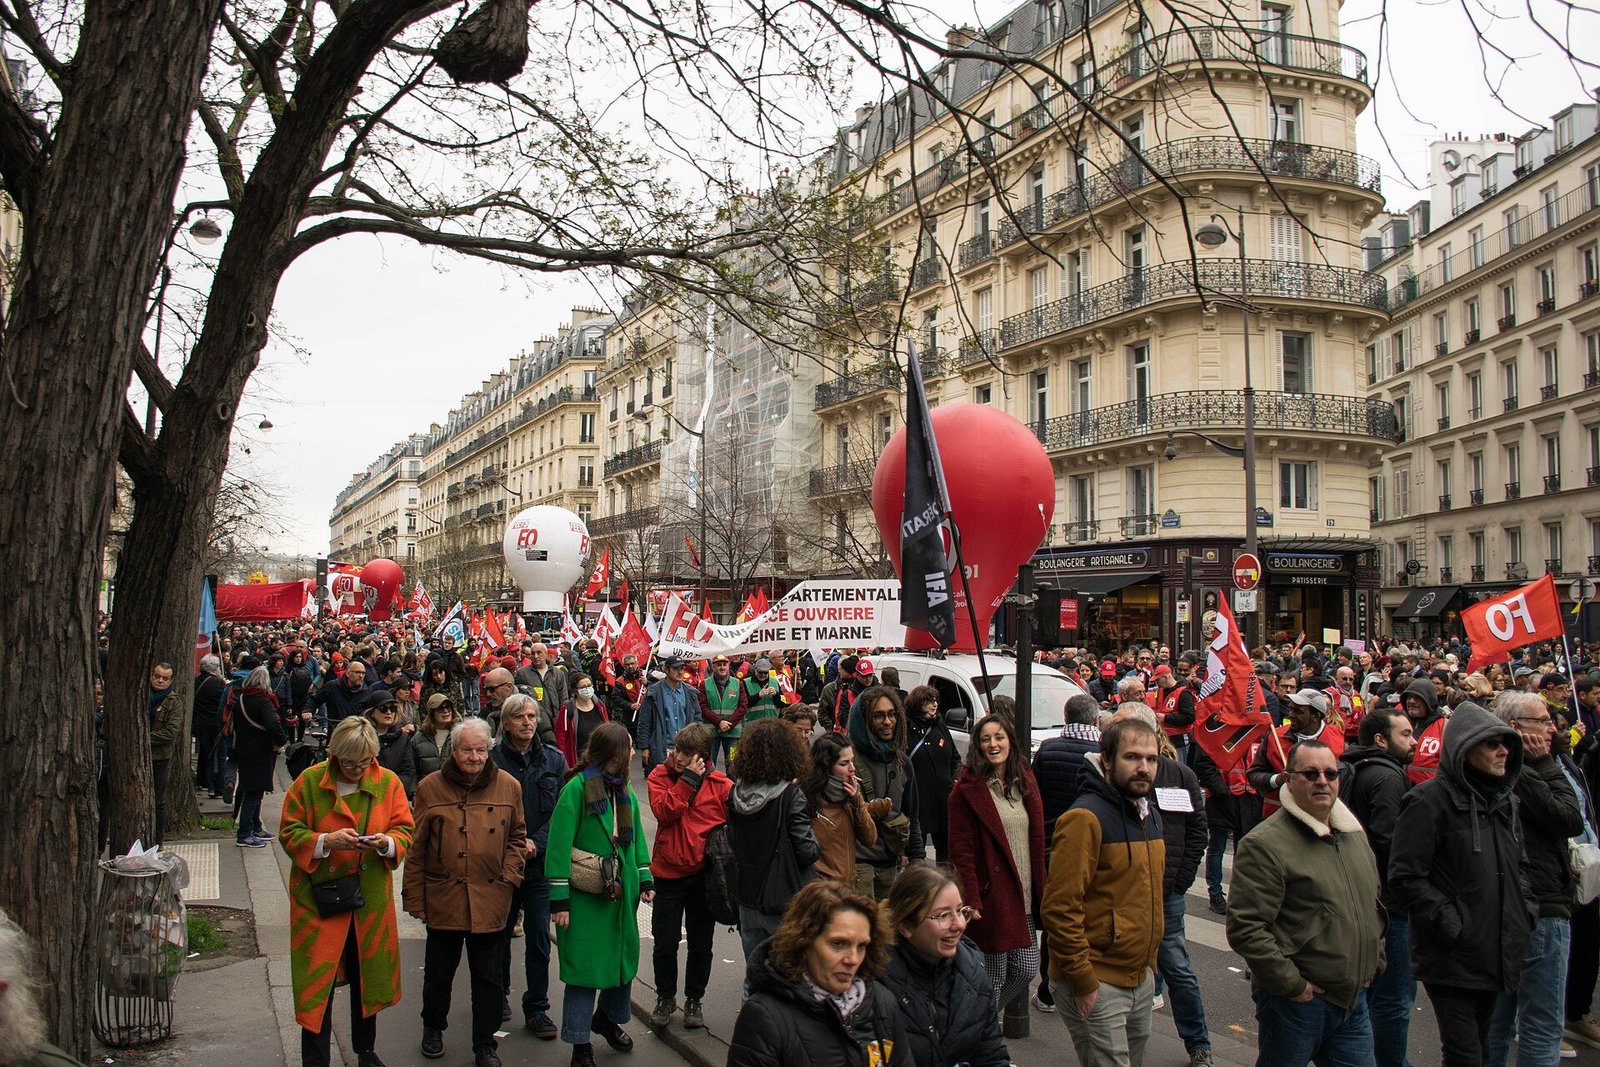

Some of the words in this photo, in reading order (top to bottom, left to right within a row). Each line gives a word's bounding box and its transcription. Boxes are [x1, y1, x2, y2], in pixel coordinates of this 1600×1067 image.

[517, 528, 538, 548] FO
[1039, 557, 1086, 569] BOULANGERIE
[1090, 554, 1133, 566] ARTISANALE
[1274, 557, 1335, 569] BOULANGERIE
[341, 578, 352, 592] FO
[1291, 577, 1327, 585] PATISSERIE
[365, 587, 375, 599] FO
[793, 607, 874, 622] OUVRIERE
[791, 627, 812, 641] ET
[815, 626, 872, 640] MARNE
[1166, 697, 1176, 709] FO
[1419, 738, 1440, 754] FO
